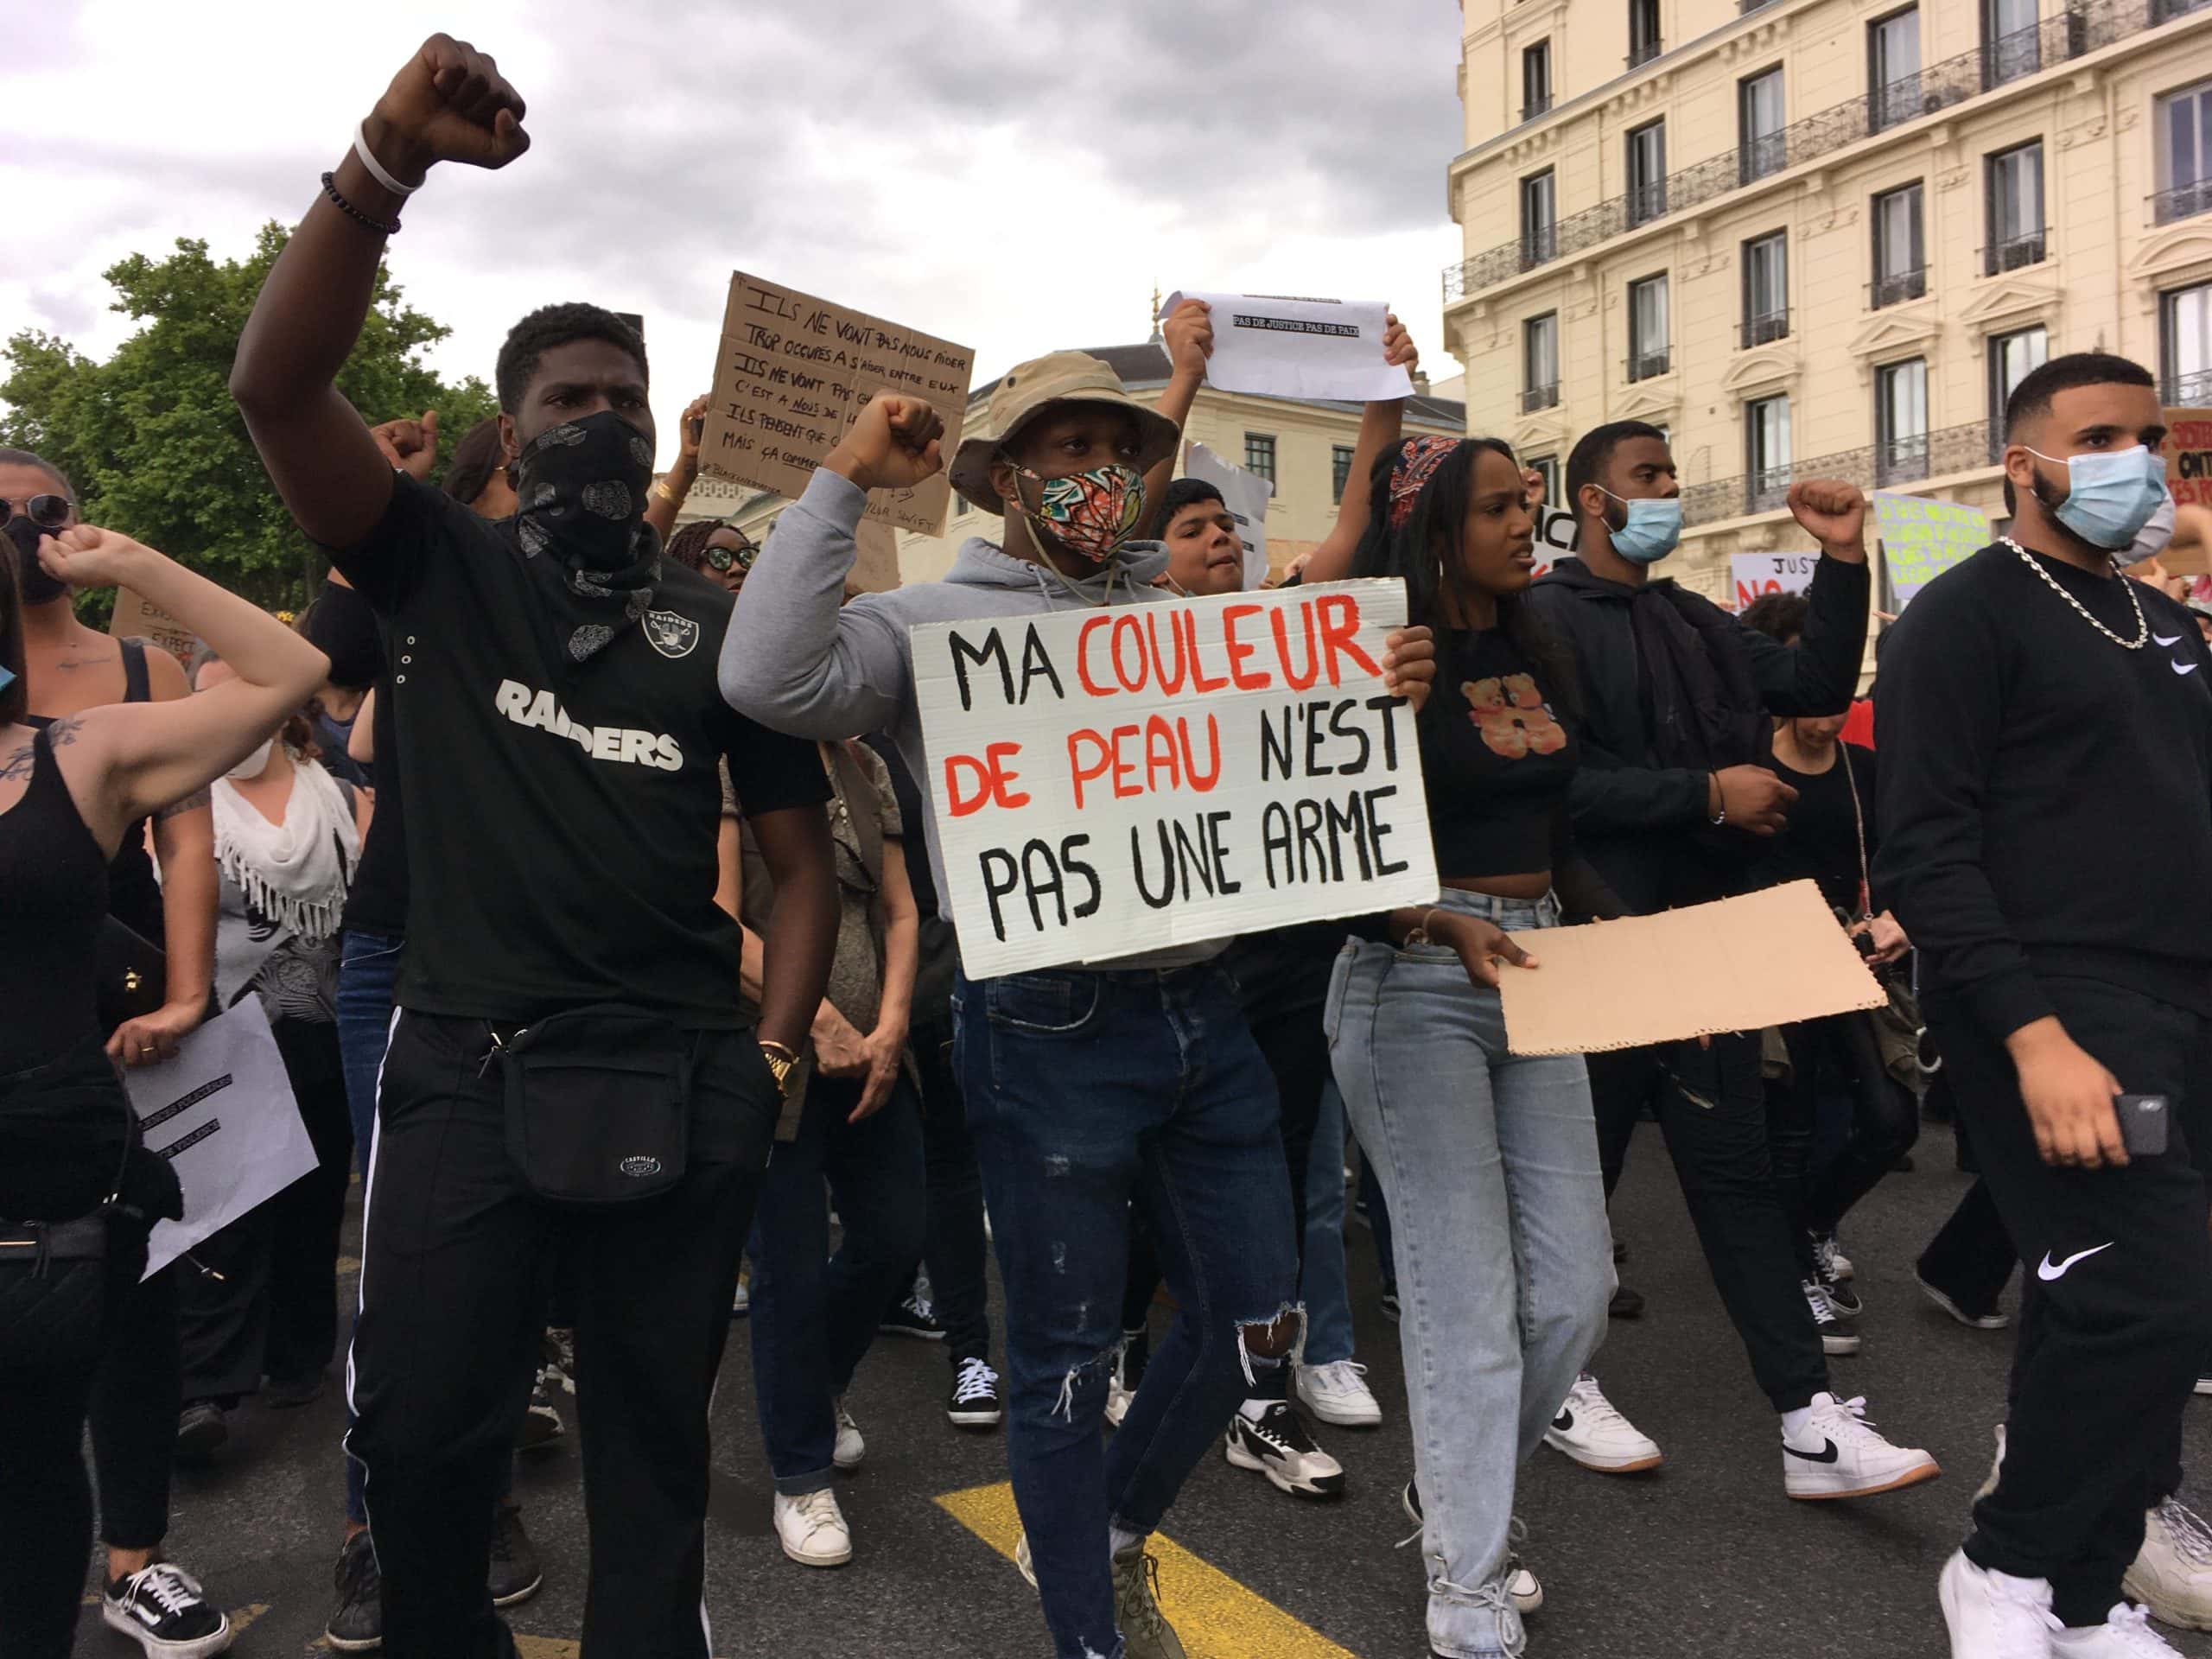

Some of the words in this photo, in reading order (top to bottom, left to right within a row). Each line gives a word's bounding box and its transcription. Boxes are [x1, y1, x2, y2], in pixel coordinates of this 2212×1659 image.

[744, 286, 801, 321] ILS
[804, 310, 831, 335] NE
[836, 319, 875, 346] VONT
[899, 343, 933, 360] NOUS
[1233, 316, 1251, 326] PAS
[1252, 317, 1266, 327] DE
[1266, 319, 1305, 332] JUSTICE
[1306, 323, 1323, 334] PAS
[1324, 324, 1337, 334] DE
[734, 352, 769, 378] ILS
[768, 365, 790, 385] NE
[791, 371, 825, 393] VONT
[830, 382, 855, 402] PAS
[745, 322, 781, 353] TROP
[833, 350, 847, 365] A
[889, 368, 924, 385] ENTRE
[928, 379, 960, 395] EUX
[727, 403, 756, 425] ILS
[806, 429, 827, 444] QUE
[734, 379, 774, 400] C'EST
[791, 397, 821, 414] NOUS
[822, 407, 839, 419] DE
[649, 613, 692, 628] RAIDERS
[948, 622, 1065, 711] MA
[1076, 594, 1383, 697] COULEUR
[944, 742, 1032, 817] DE
[1067, 713, 1221, 810] PEAU
[1261, 696, 1408, 781] N'EST
[980, 833, 1101, 942] PAS
[1131, 810, 1241, 909] UNE
[1262, 785, 1409, 890] ARME
